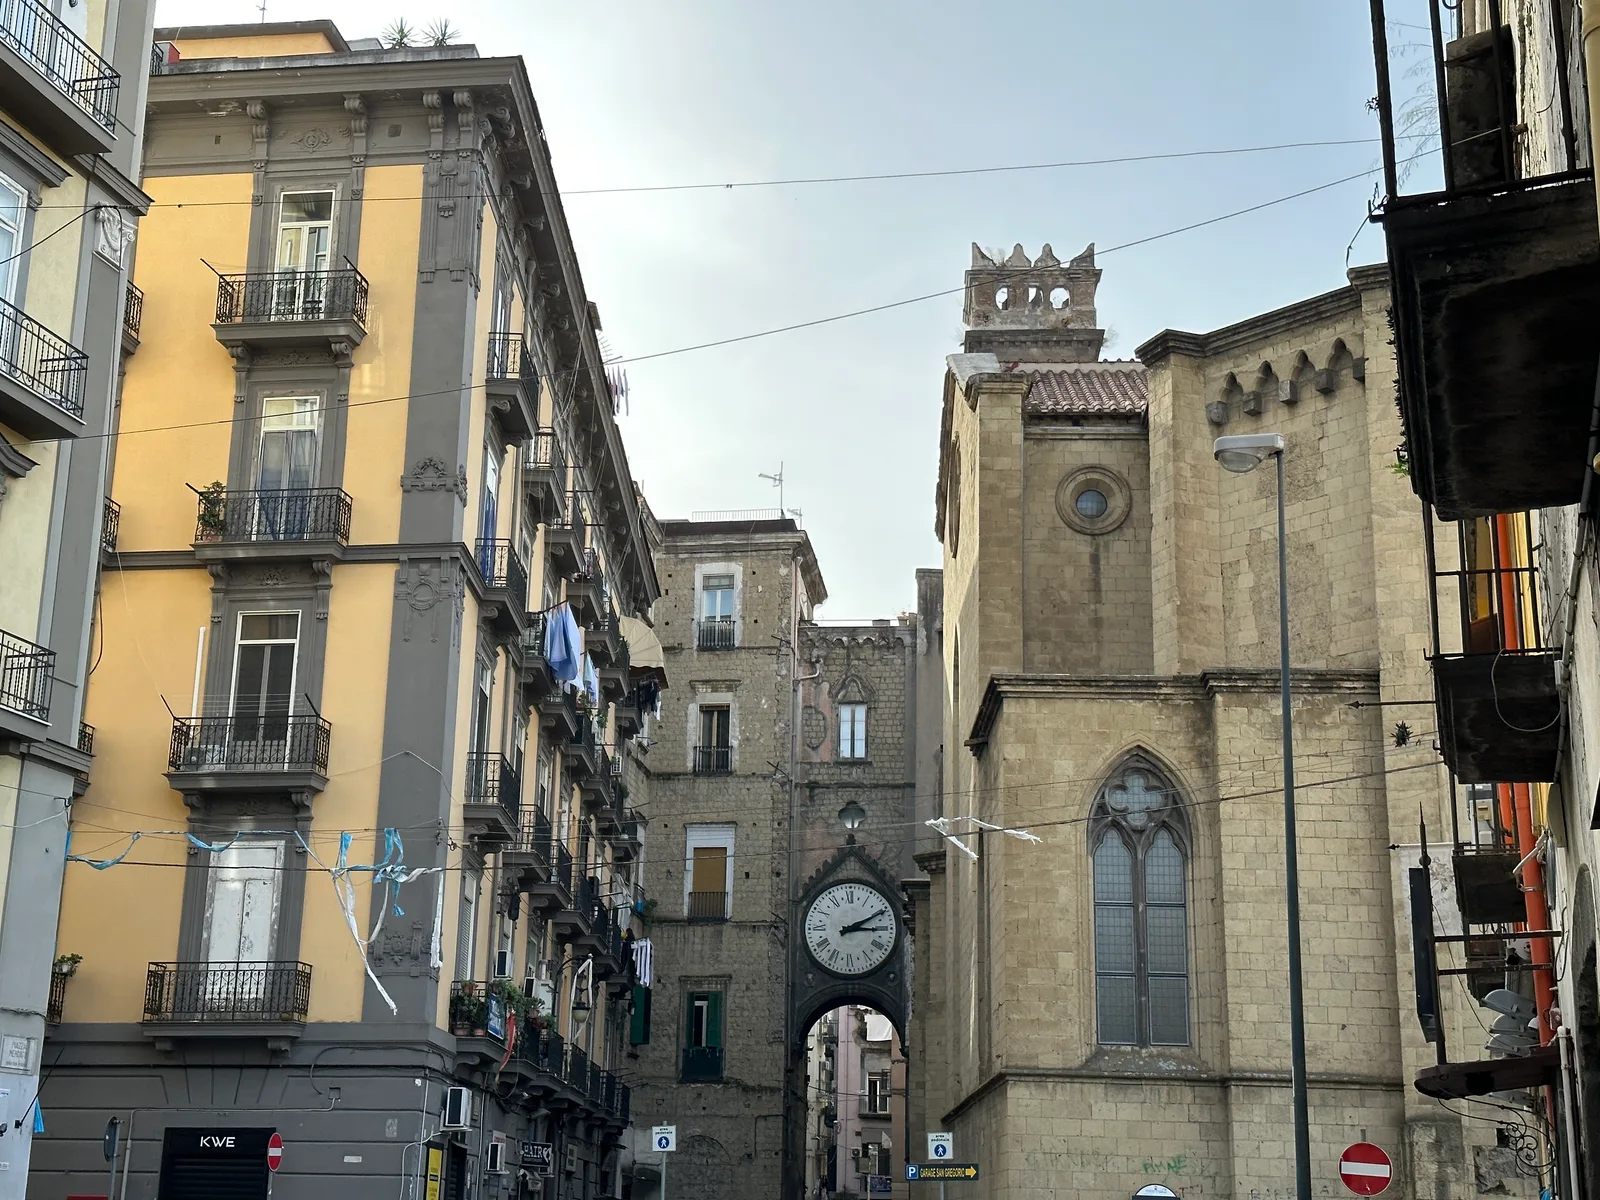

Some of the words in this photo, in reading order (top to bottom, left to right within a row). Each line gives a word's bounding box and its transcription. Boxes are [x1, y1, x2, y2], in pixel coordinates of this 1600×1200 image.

[200, 1136, 236, 1147] KWE
[920, 1168, 936, 1178] GARAGE
[936, 1168, 945, 1178] SAN
[945, 1168, 965, 1178] GREGORIO
